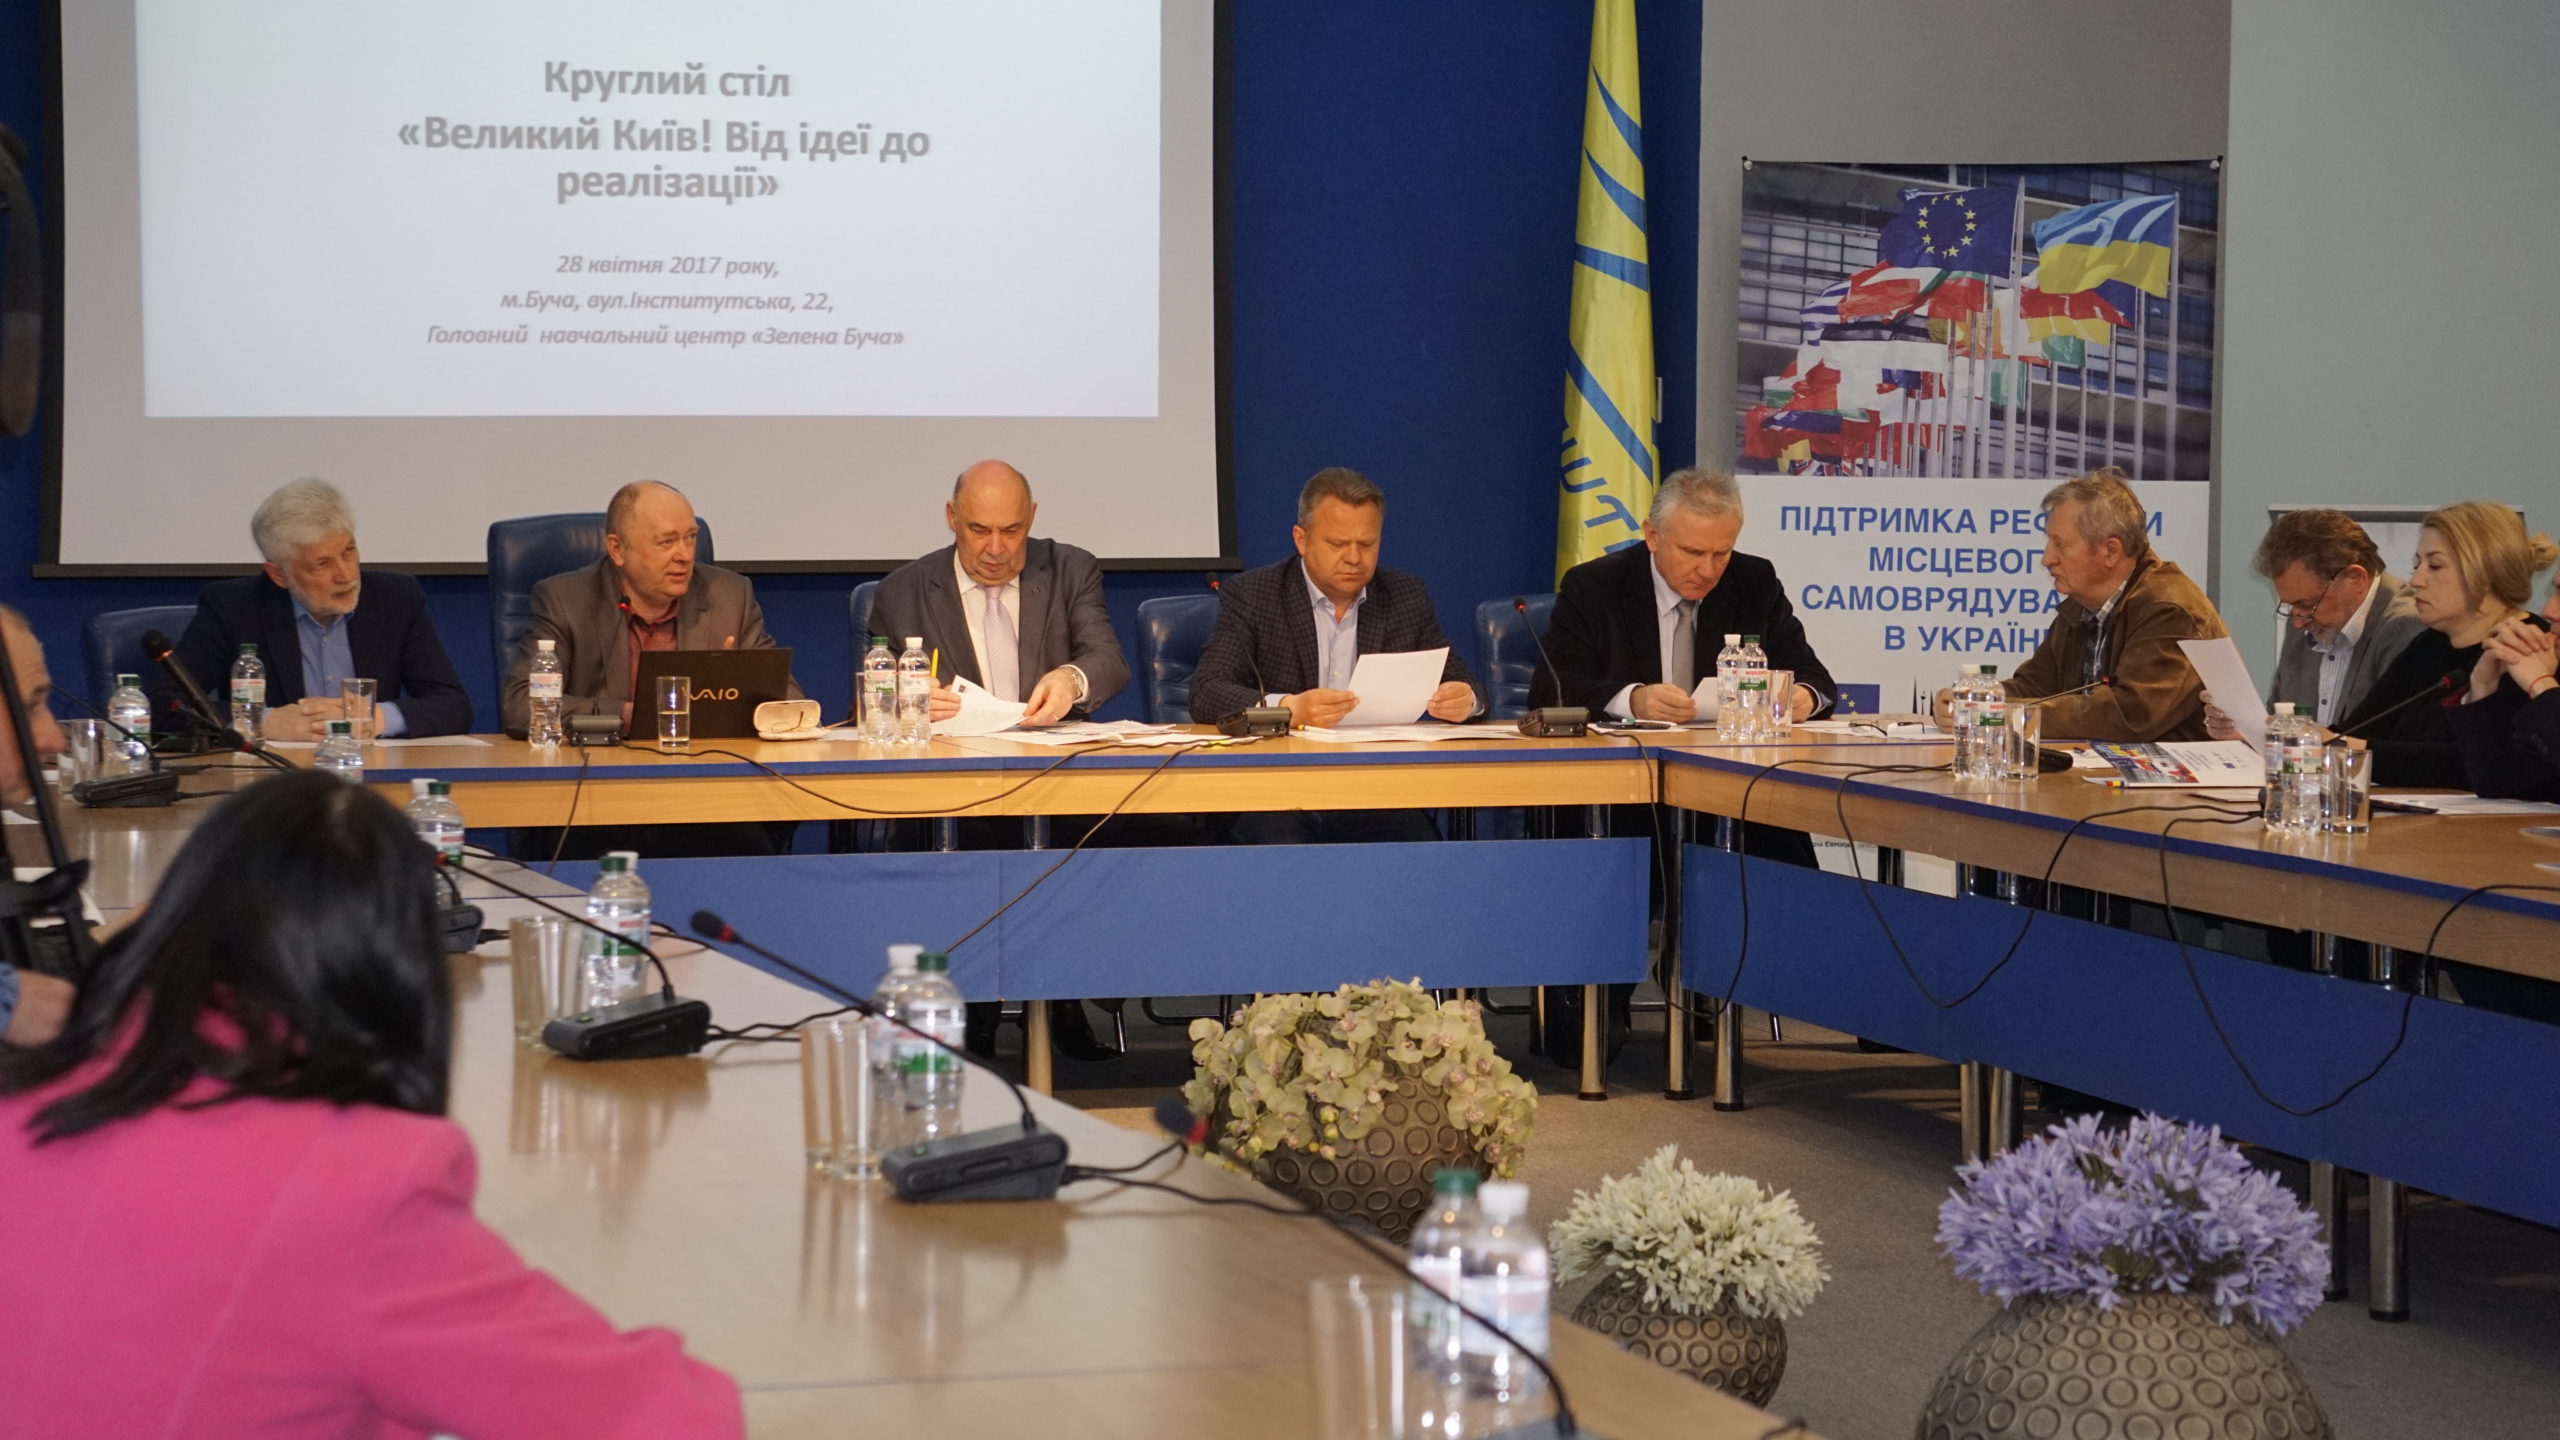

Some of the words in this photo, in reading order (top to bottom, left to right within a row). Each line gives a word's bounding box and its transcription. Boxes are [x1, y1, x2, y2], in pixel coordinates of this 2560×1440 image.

[544, 61, 707, 102] Круглий
[718, 65, 790, 97] стіл
[397, 116, 601, 151] «Великий
[613, 119, 712, 153] Київ!
[725, 121, 789, 161] Від
[799, 122, 873, 162] ідеї
[879, 131, 931, 163] до
[556, 164, 779, 205] реалізації»
[555, 255, 583, 274] 28
[587, 255, 664, 275] квітня
[668, 256, 721, 276] 2017
[724, 260, 780, 279] року,
[499, 290, 581, 314] м.Буча,
[586, 291, 796, 314] вул.Інститутська,
[802, 293, 834, 314] 22,
[427, 324, 529, 345] Головний
[538, 325, 669, 345] навчальний
[673, 330, 747, 350] центр
[751, 327, 839, 346] «Зелена
[843, 327, 905, 347] Буча»
[1780, 505, 1978, 537] ПІДТРИМКА
[1869, 546, 2050, 577] МІСЦЕВОГ
[1801, 583, 2062, 618] САМОВРЯДУВА
[1884, 625, 1906, 651] В
